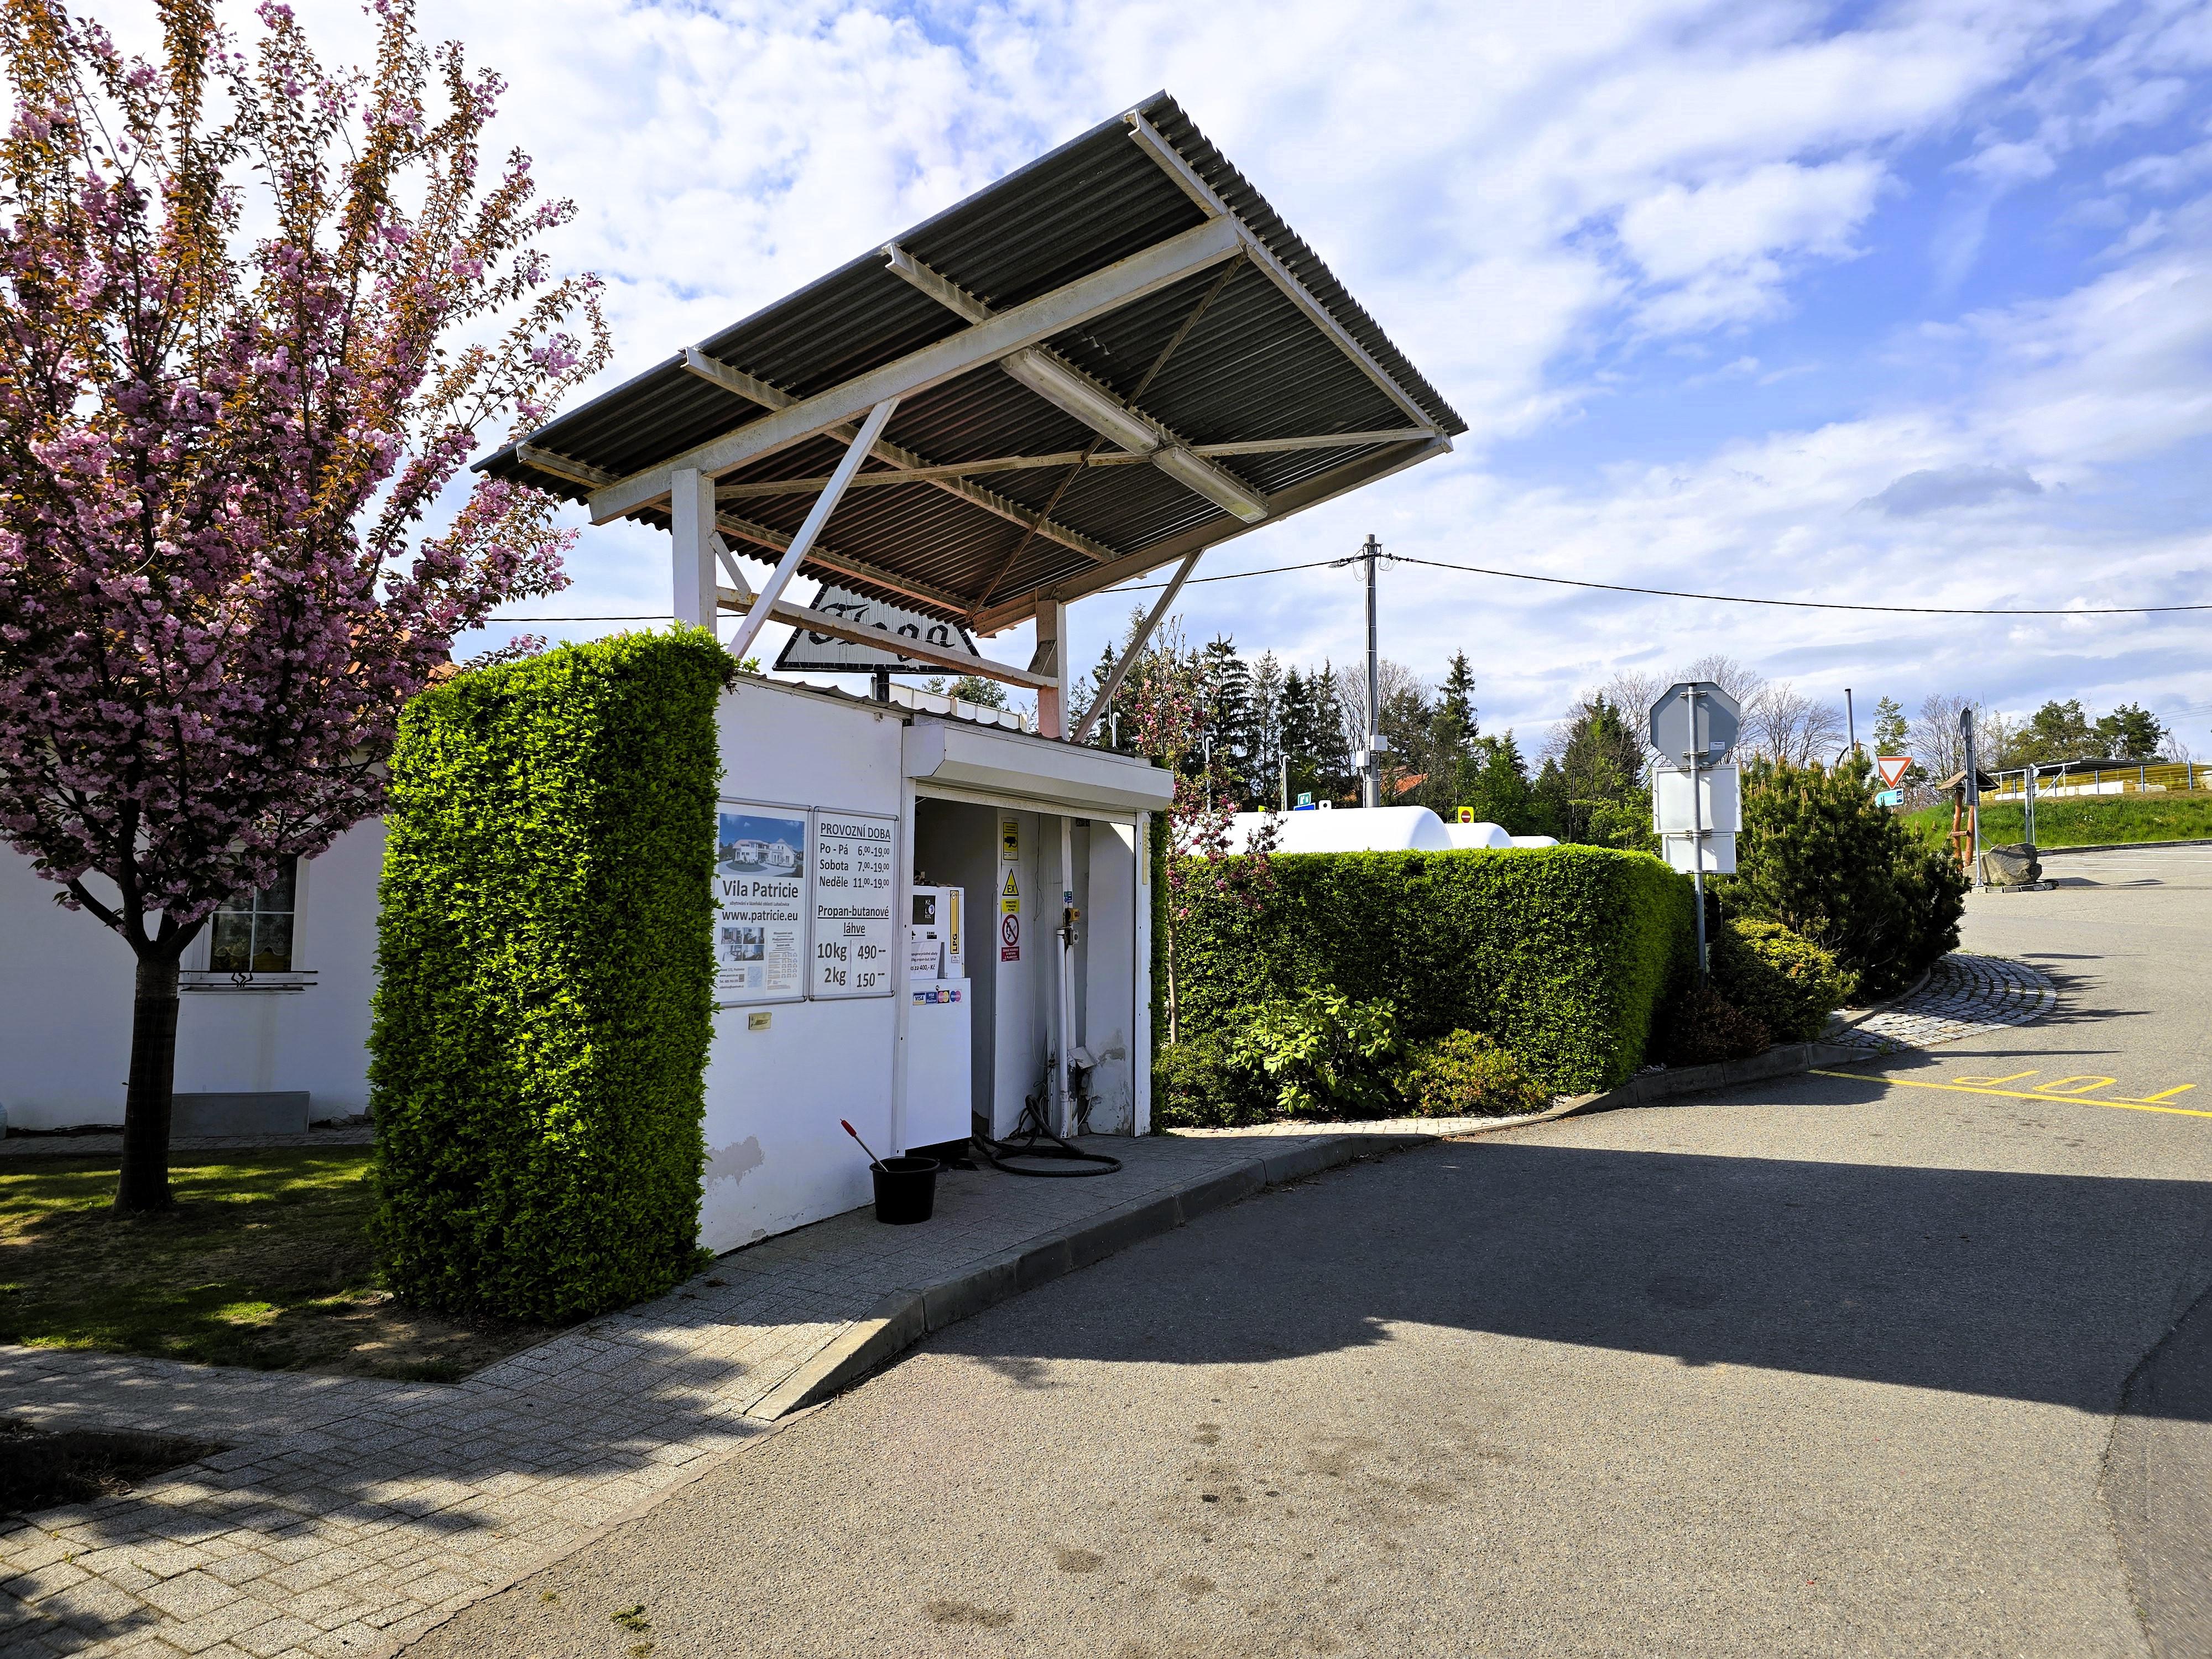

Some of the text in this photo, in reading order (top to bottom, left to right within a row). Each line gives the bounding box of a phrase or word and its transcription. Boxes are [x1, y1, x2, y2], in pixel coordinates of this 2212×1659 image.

[821, 823, 891, 839] PROVOZNÍ DOBA
[820, 843, 831, 853] Po
[838, 844, 848, 854] Pá
[820, 859, 849, 871] Sobota
[819, 876, 848, 887] Neděle
[722, 880, 799, 898] Vila Patricie
[1008, 885, 1015, 893] EX
[722, 909, 798, 923] www.patricie.eu
[818, 905, 889, 917] Propan-butanové
[843, 922, 865, 933] láhve
[1952, 1070, 2198, 1105] TOP
